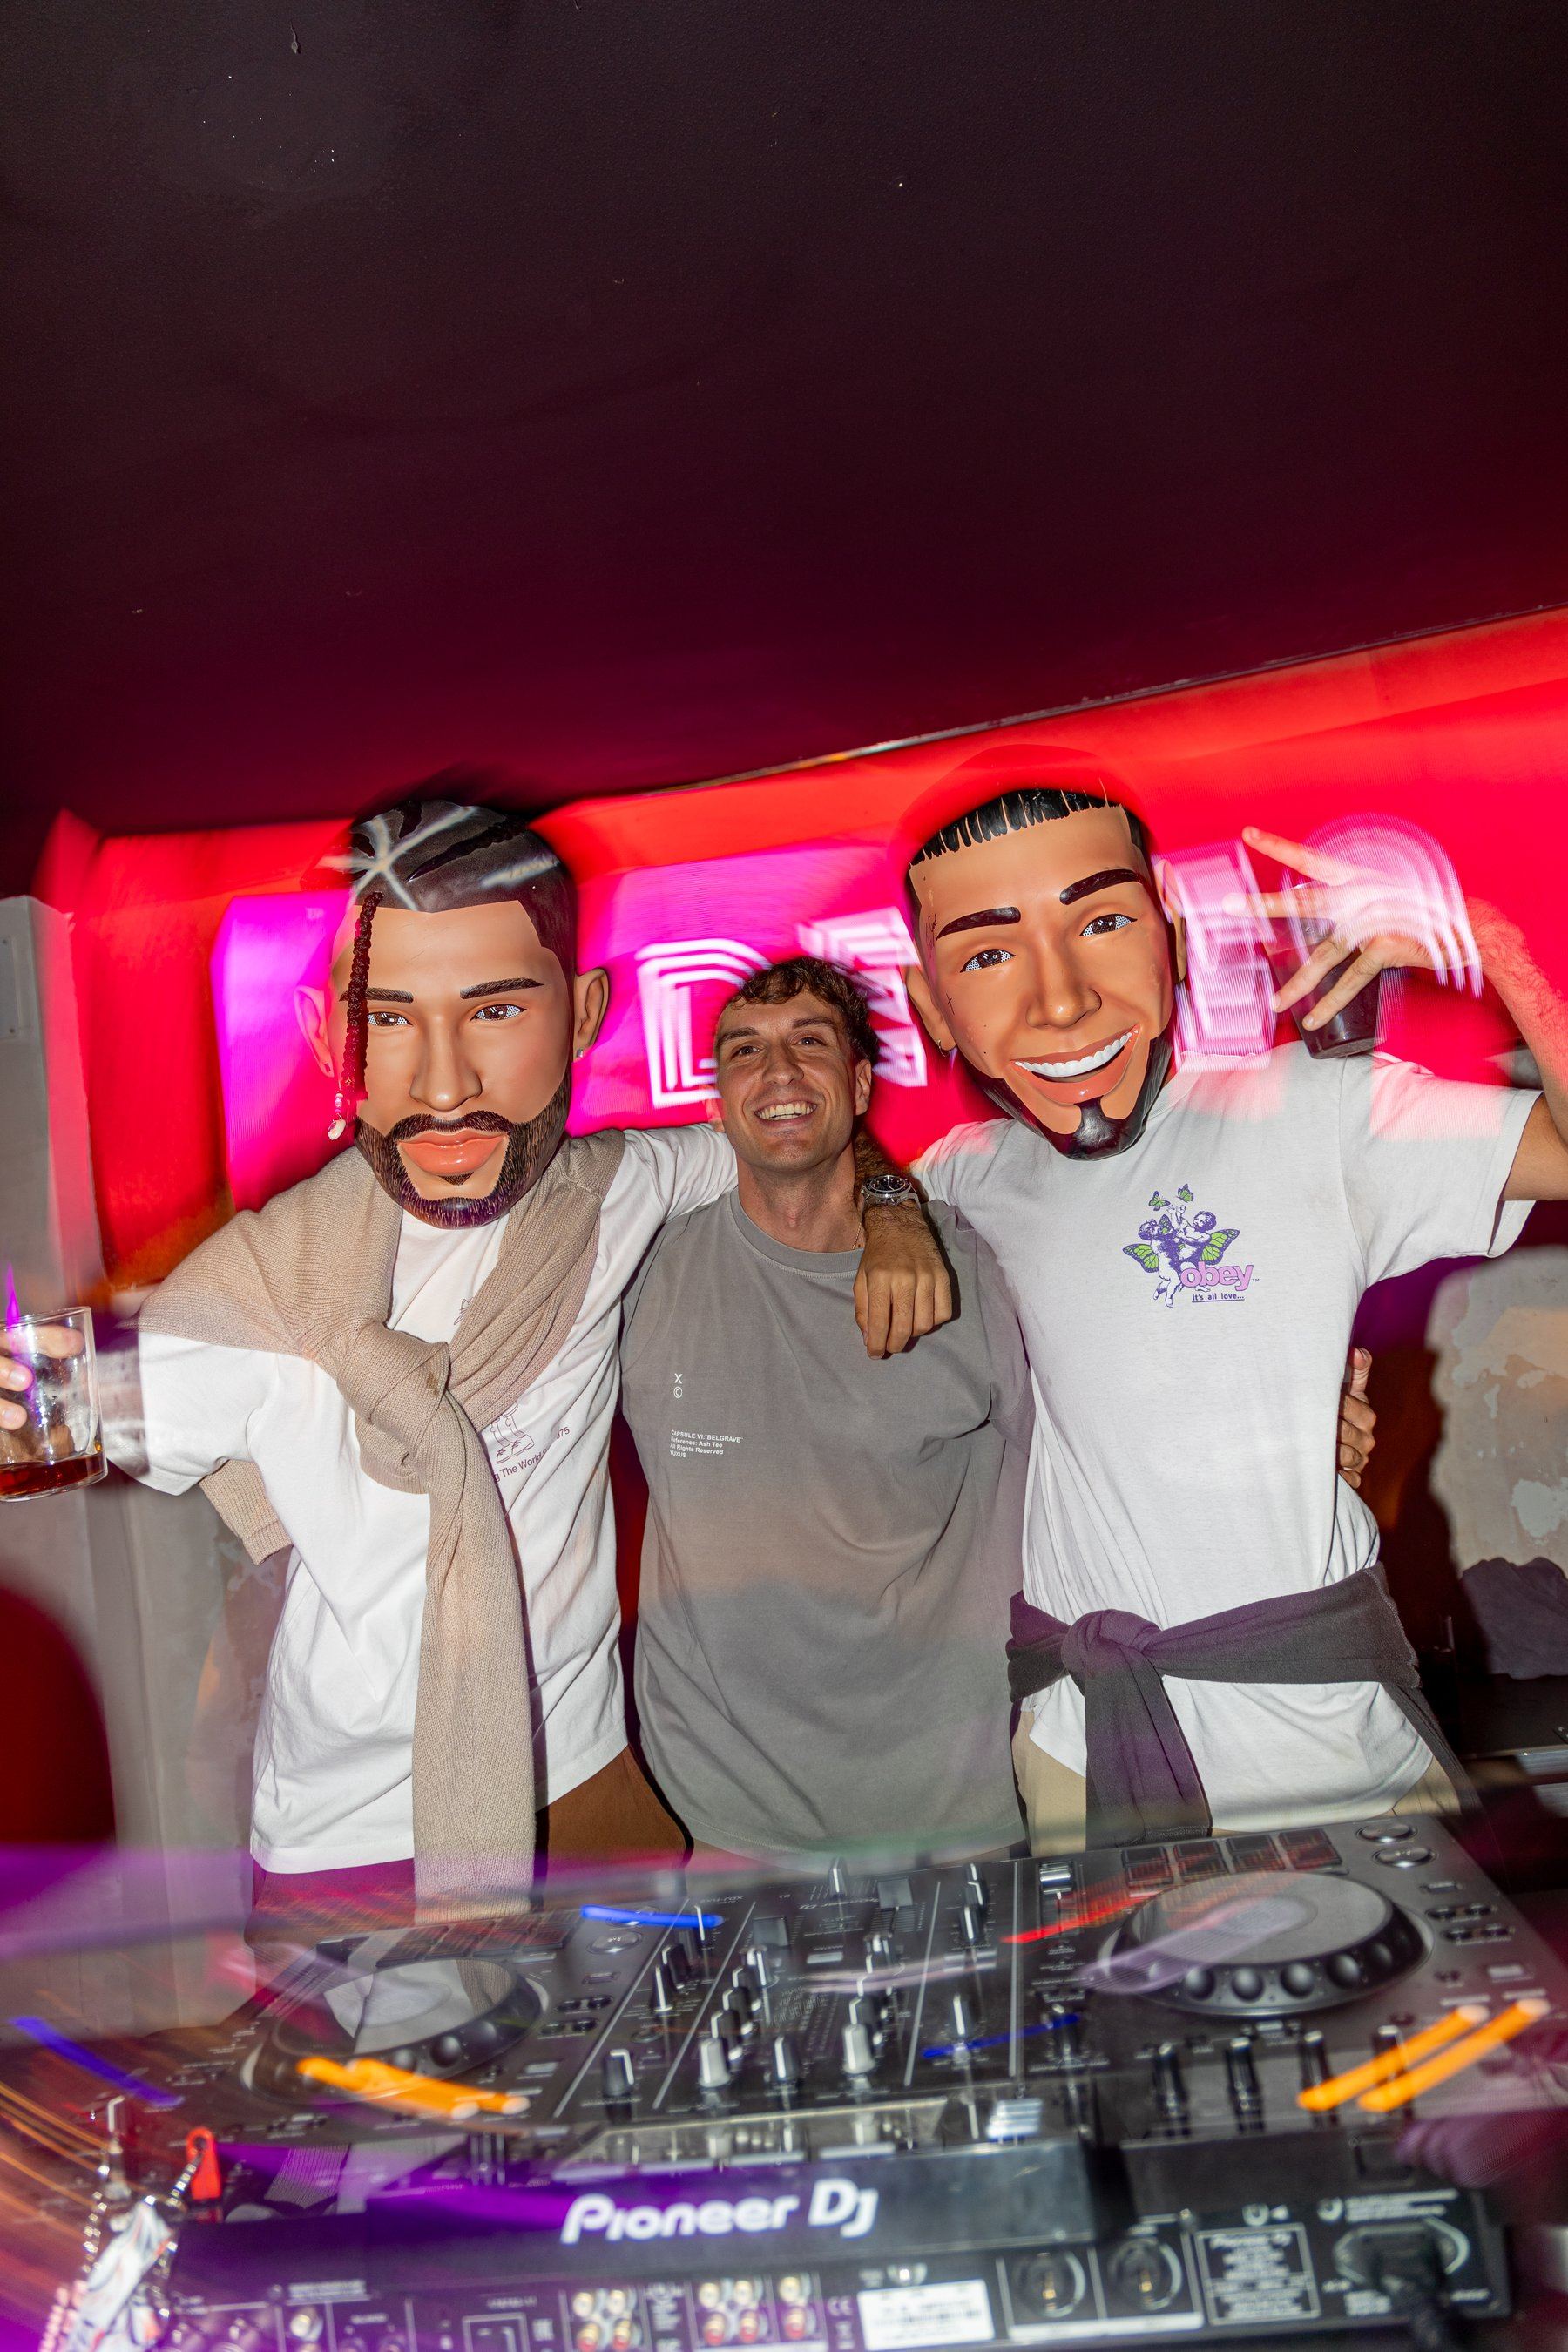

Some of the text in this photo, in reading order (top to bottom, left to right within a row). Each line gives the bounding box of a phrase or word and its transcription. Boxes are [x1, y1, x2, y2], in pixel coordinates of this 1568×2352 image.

[1180, 1260, 1254, 1291] obey
[671, 1429, 696, 1439] CAPSULE
[500, 1465, 518, 1477] The
[560, 2178, 879, 2244] Pioneer DJ
